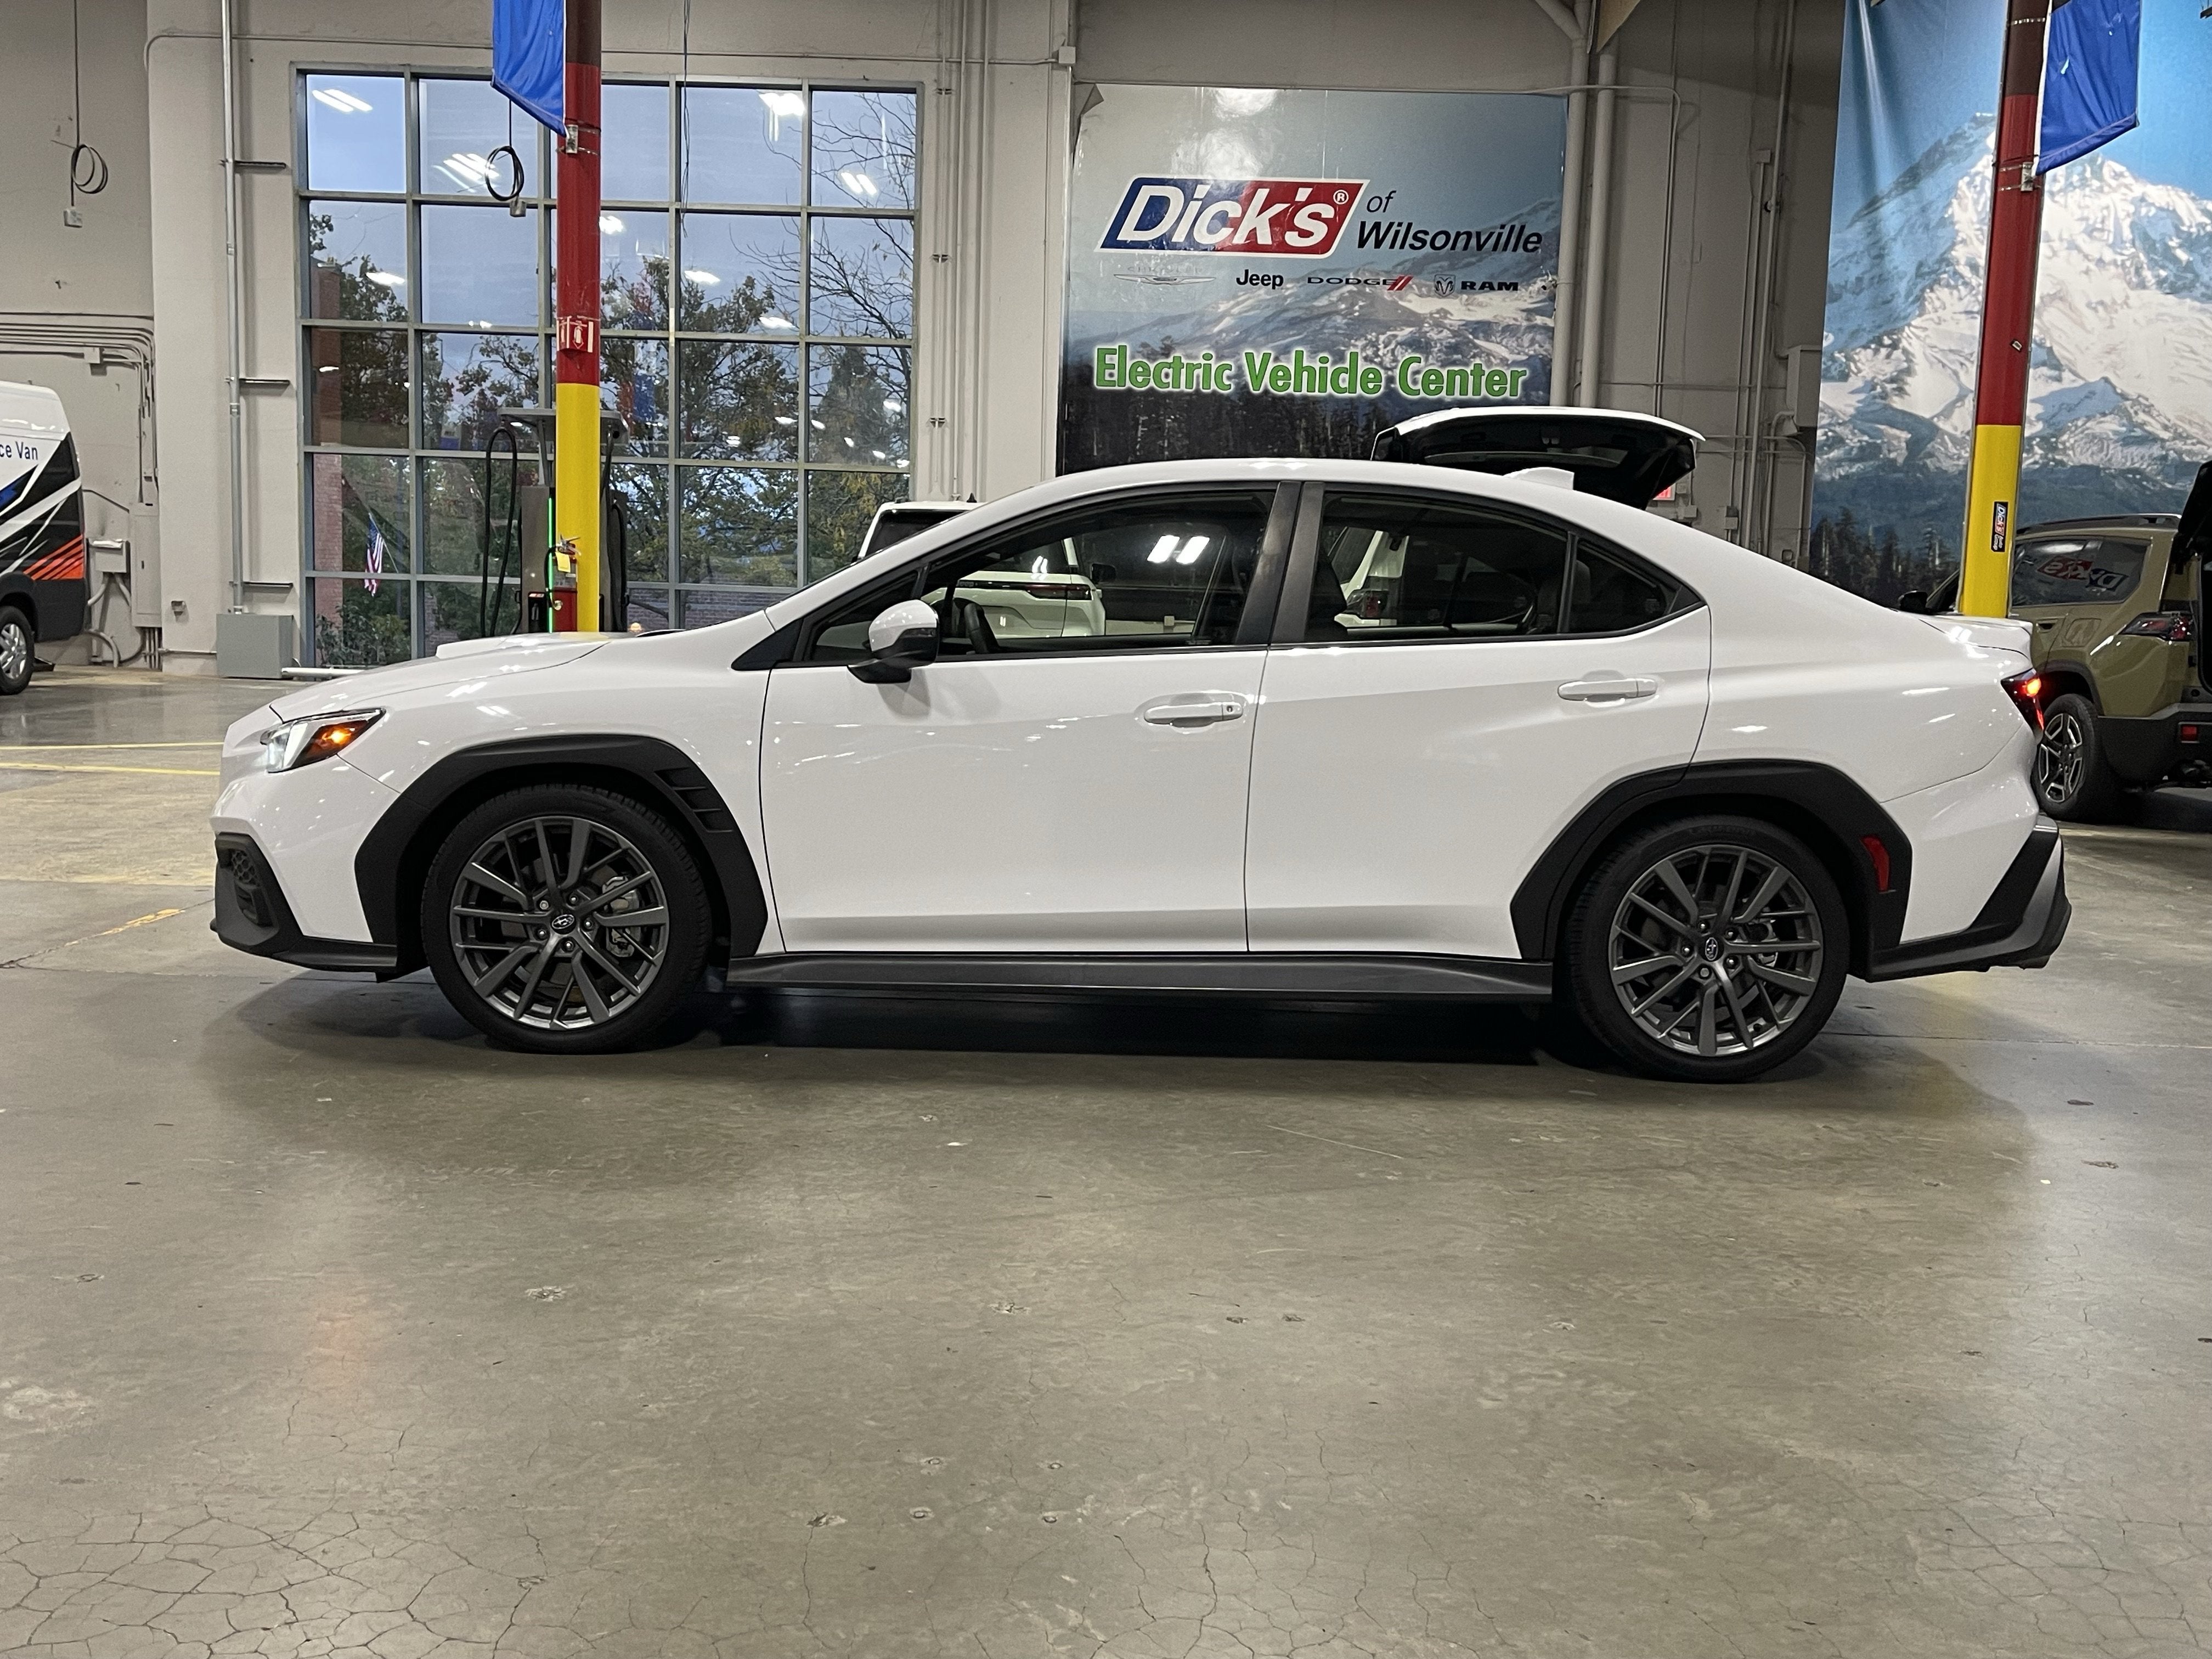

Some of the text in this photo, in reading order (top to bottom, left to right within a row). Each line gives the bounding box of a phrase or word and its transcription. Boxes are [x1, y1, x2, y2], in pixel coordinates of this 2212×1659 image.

[1367, 190, 1396, 213] of
[1357, 221, 1543, 253] Wilsonville
[1236, 269, 1284, 290] Jeep
[1307, 276, 1397, 286] DODGE
[1461, 280, 1519, 291] RAM
[1097, 345, 1527, 397] Electric Vehicle Center
[15, 441, 38, 460] Van
